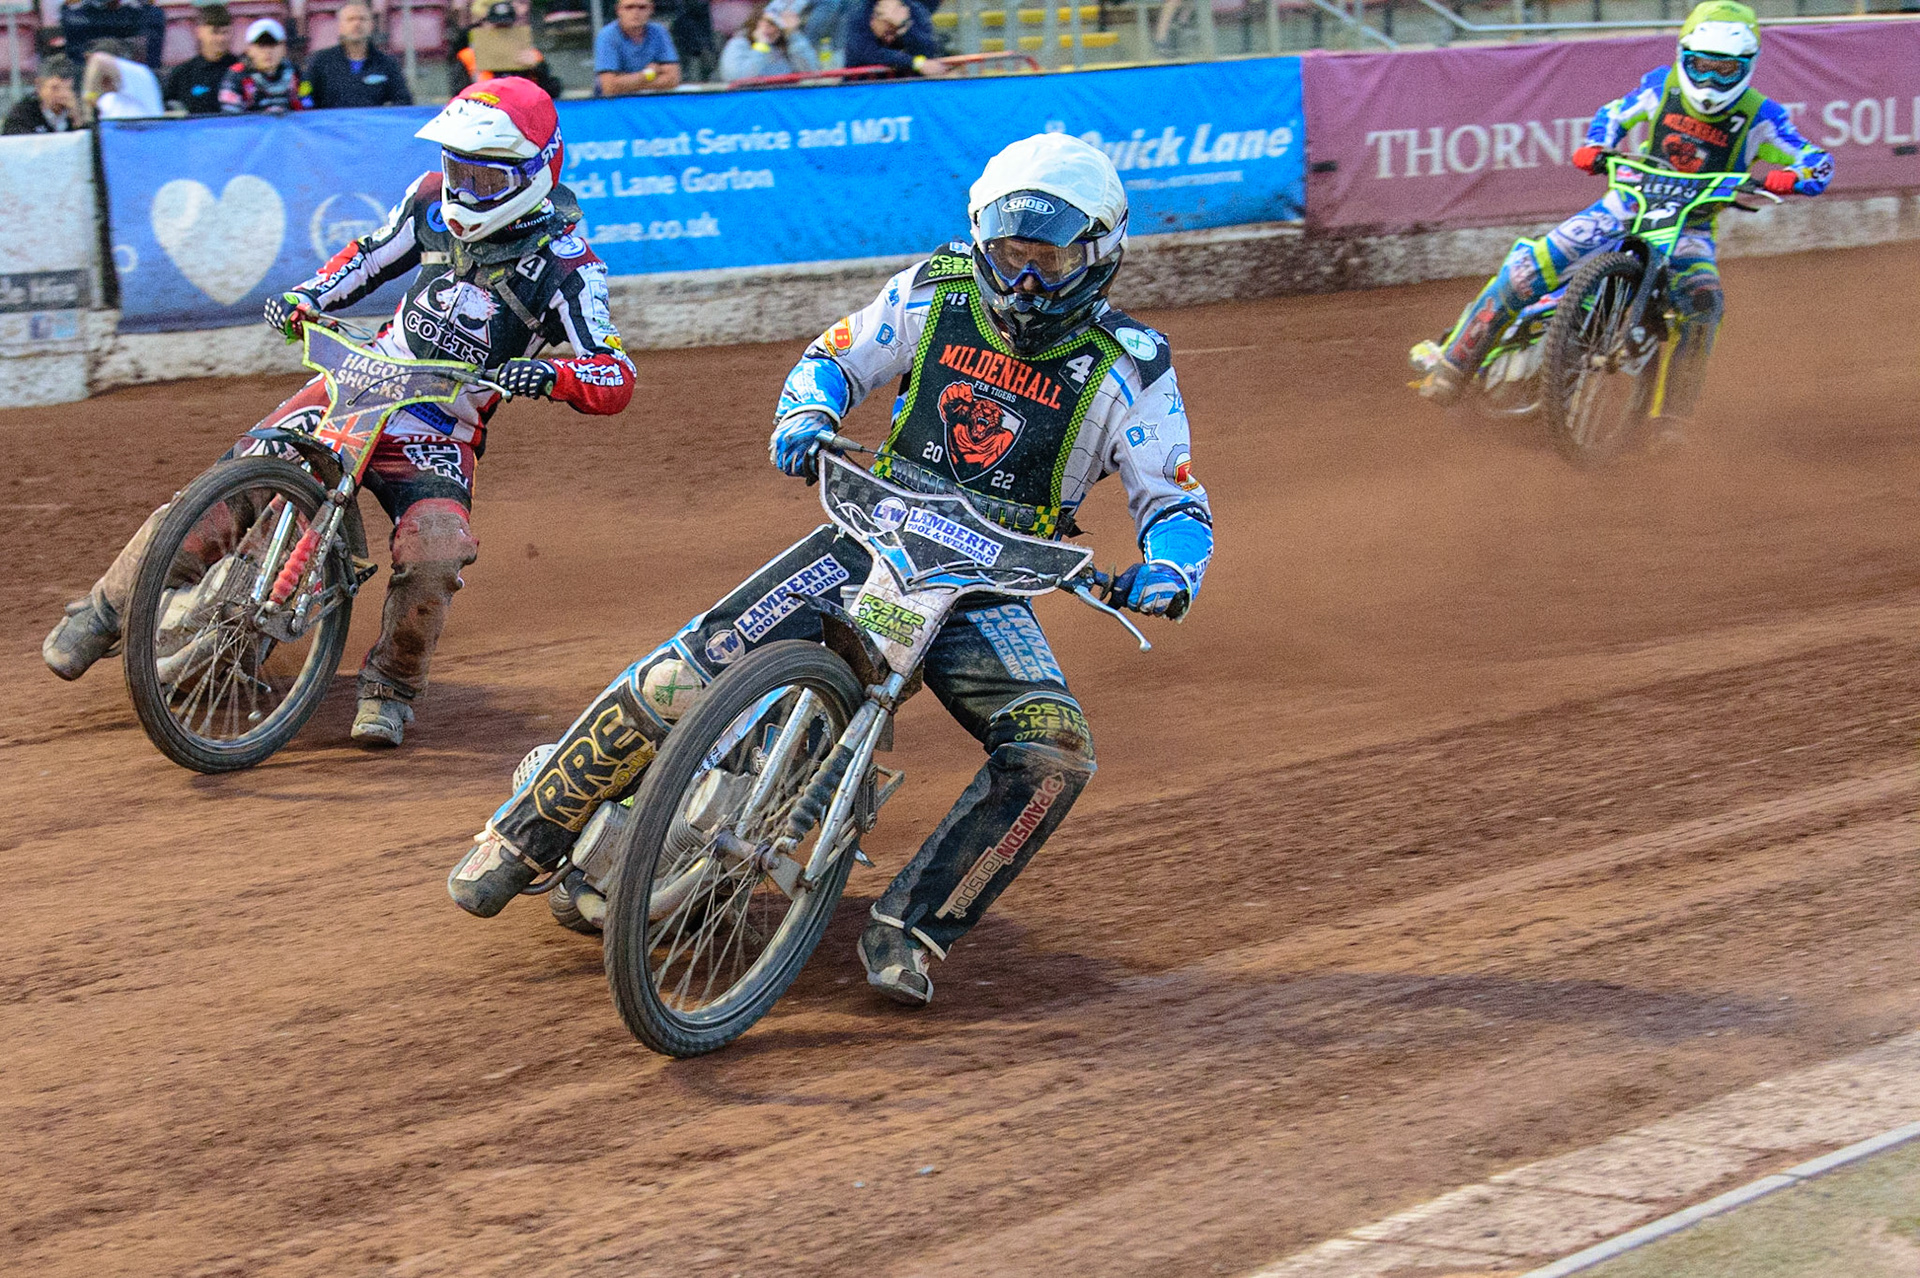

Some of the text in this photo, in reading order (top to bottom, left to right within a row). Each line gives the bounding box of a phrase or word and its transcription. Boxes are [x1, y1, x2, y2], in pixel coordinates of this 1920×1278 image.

[567, 116, 913, 170] your next Service and MOT
[1187, 123, 1293, 165] Lane
[611, 169, 677, 197] Lane
[681, 166, 775, 193] Gorton
[1008, 199, 1049, 212] SHOEI
[523, 257, 543, 278] 4
[405, 311, 489, 366] COLTS
[336, 368, 406, 401] SHOCKS
[341, 353, 413, 384] HAGON
[939, 344, 1063, 411] MILDENHALL
[1066, 353, 1095, 384] 4
[974, 381, 1017, 403] FEN TIGERS
[922, 441, 944, 463] 20
[990, 470, 1015, 490] 22
[906, 523, 931, 536] TOOL
[942, 534, 994, 566] WELDING
[909, 508, 1000, 558] LAMBERTS
[738, 556, 839, 632] LAMBERTS
[748, 612, 781, 641] TOOL
[860, 594, 926, 631] FOSTER
[996, 791, 1052, 860] PAWSON
